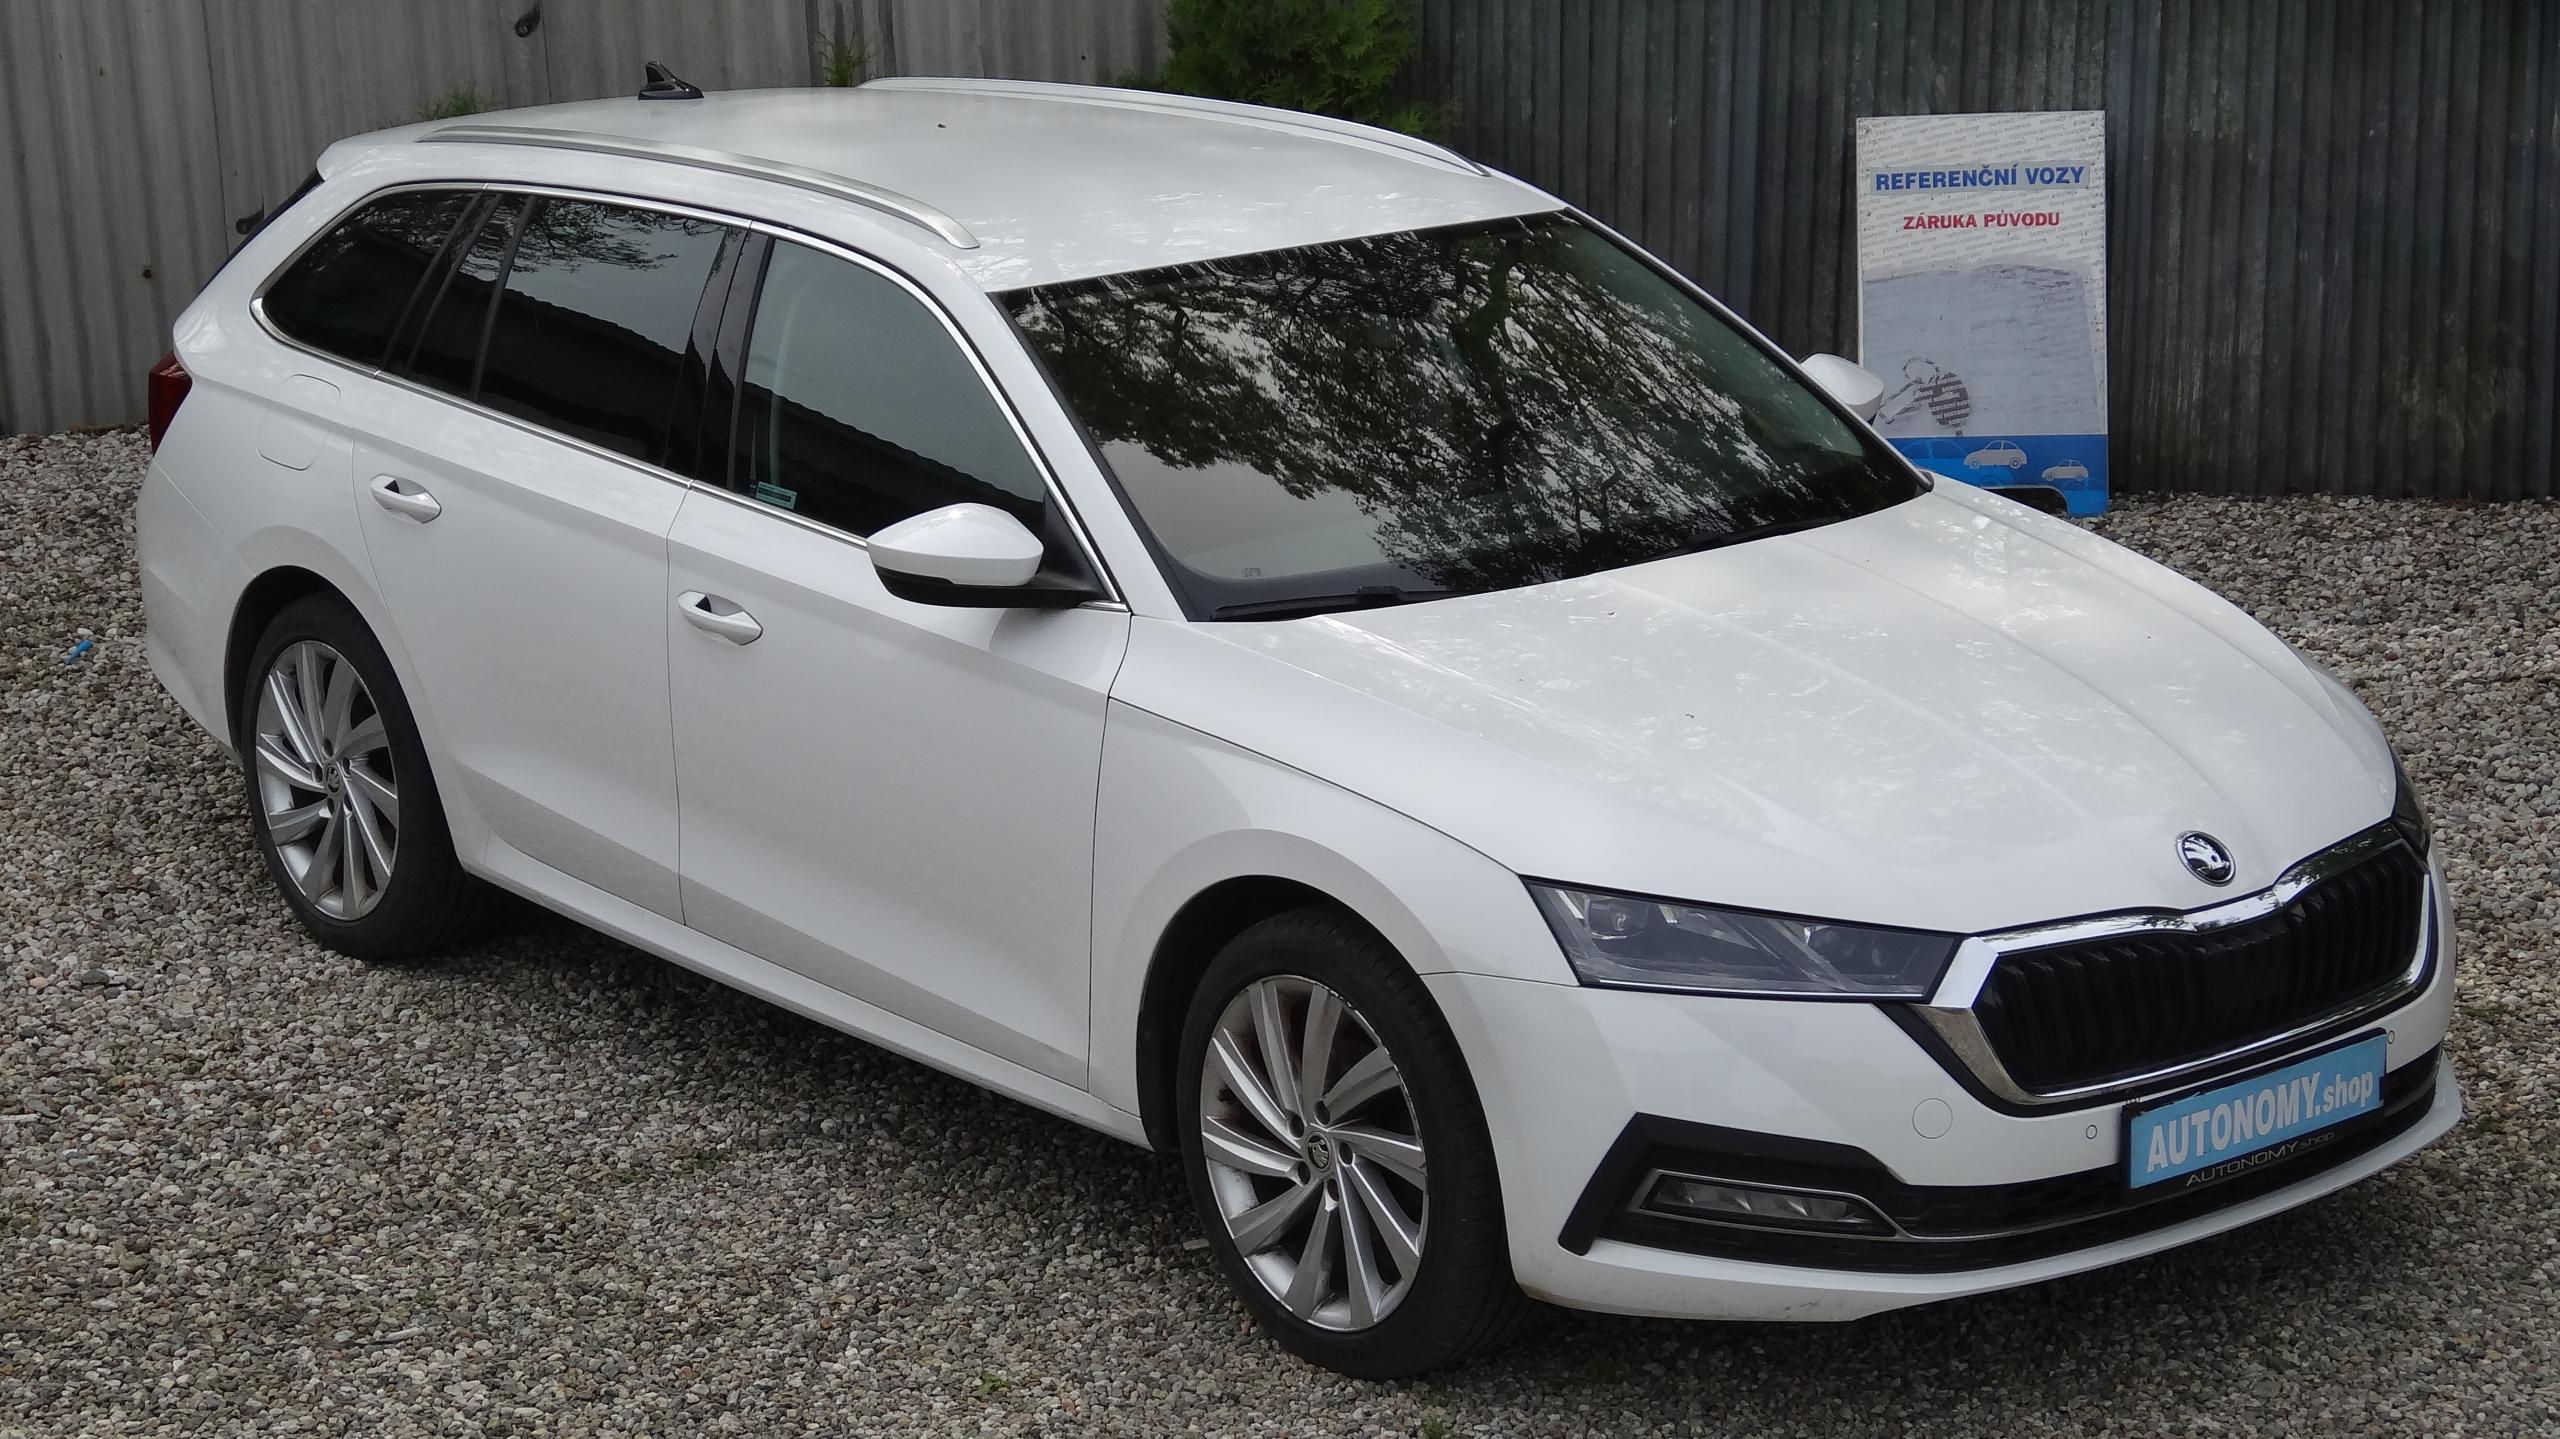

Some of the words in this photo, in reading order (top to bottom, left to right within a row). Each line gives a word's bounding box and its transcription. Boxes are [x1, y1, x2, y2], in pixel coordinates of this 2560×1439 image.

[1876, 163, 2018, 191] REFERENČNÍ
[2025, 166, 2085, 185] VOZY
[1903, 212, 1977, 230] ZÁRUKA
[1983, 210, 2060, 228] PŮVODU
[2146, 1071, 2374, 1172] AUTONOMY.shop
[2185, 1141, 2298, 1187] AUTONOMY
